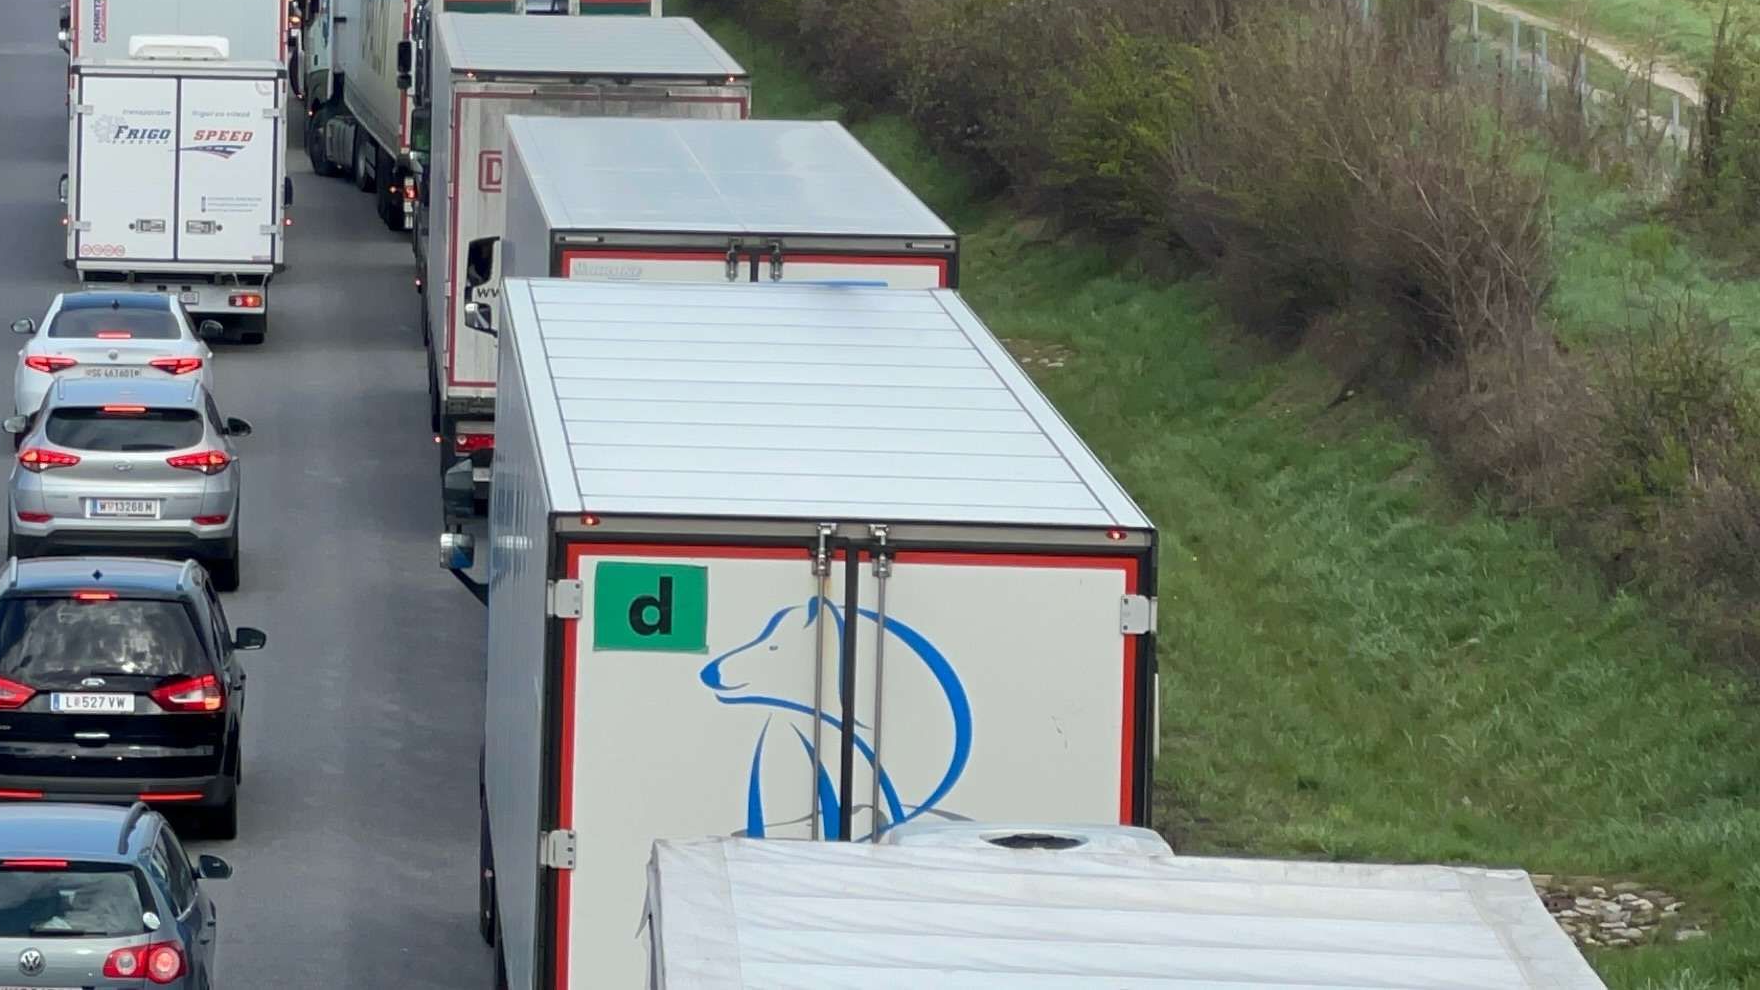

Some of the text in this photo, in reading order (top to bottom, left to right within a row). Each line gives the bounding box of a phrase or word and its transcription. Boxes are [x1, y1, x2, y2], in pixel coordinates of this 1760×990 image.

[114, 125, 254, 142] FRIGO SPEED
[629, 576, 673, 636] d
